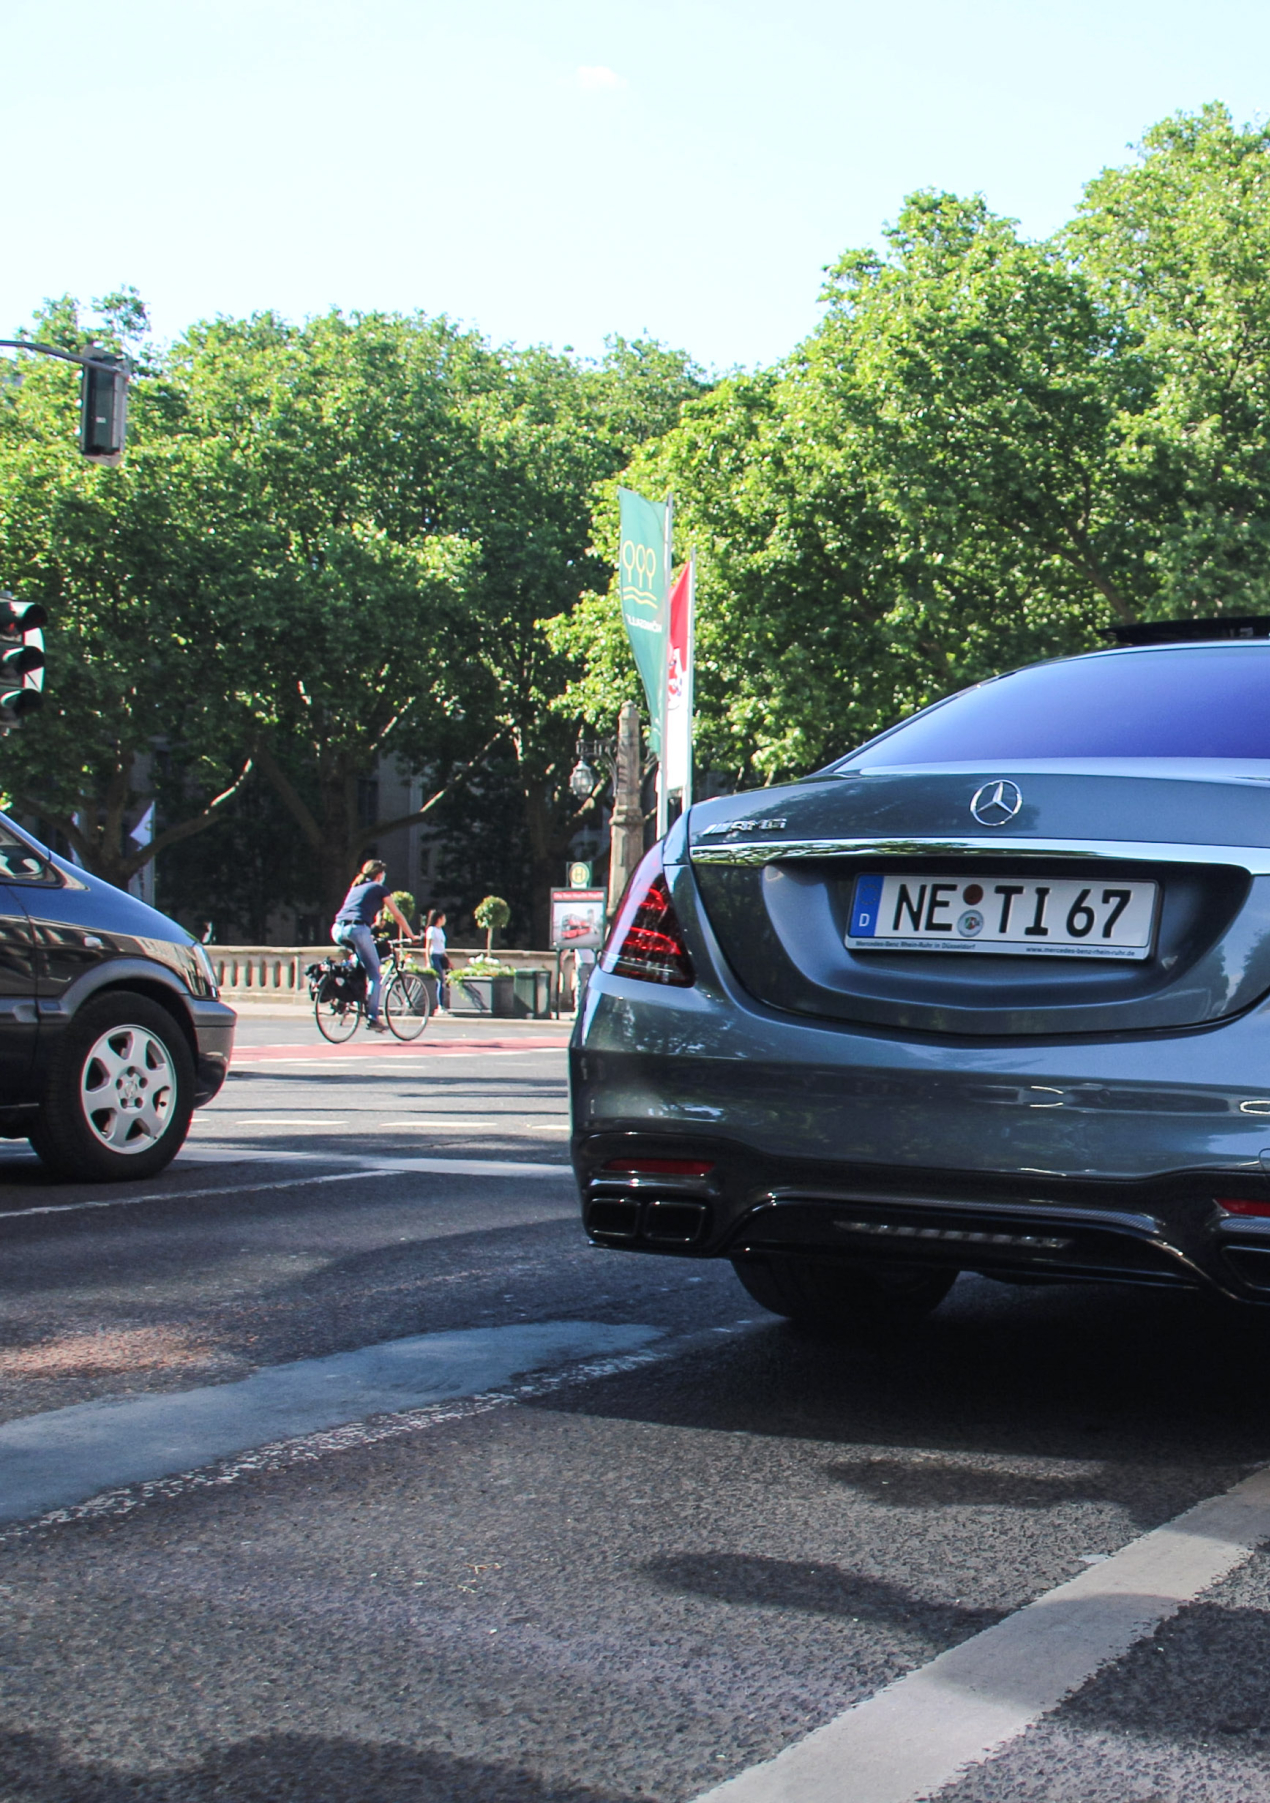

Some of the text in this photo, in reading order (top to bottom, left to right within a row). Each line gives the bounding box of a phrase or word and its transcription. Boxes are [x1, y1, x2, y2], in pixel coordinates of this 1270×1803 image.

[892, 883, 1133, 939] NE TI 67
[858, 913, 870, 928] D
[900, 941, 933, 949] Rhein-Ruhr
[942, 942, 976, 950] Düsseldorf
[1026, 946, 1135, 957] www.mercedes-benz-rhein-ruhr.de
